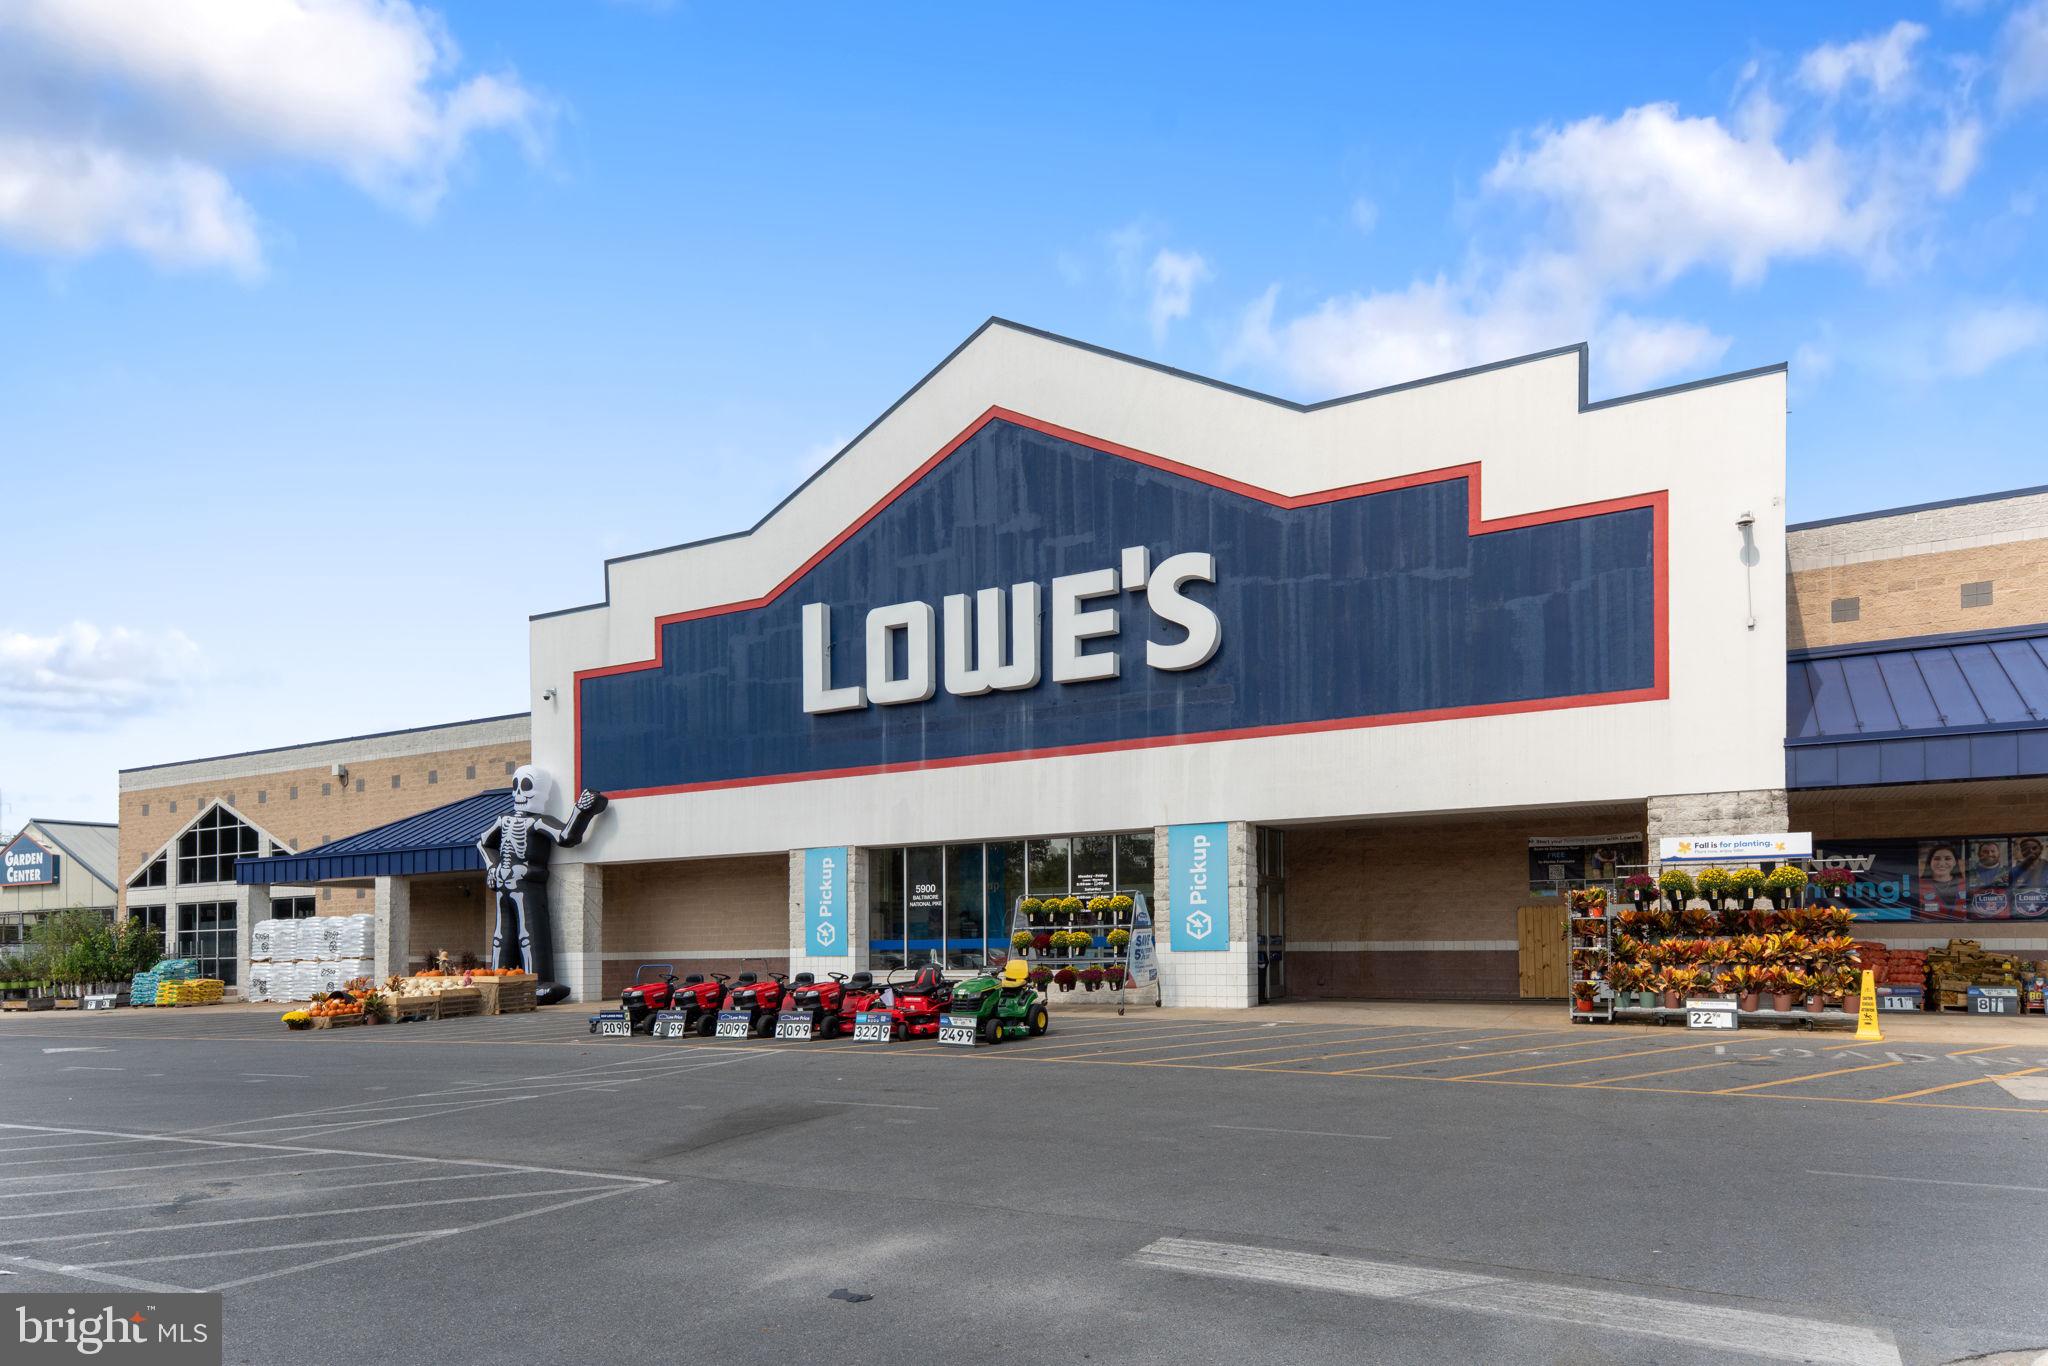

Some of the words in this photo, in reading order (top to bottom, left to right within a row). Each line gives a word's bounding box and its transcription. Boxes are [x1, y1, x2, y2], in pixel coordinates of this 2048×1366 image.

[802, 545, 1221, 715] LOWE'S
[1734, 840, 1773, 849] planting.
[5, 851, 43, 866] GARDEN
[7, 867, 41, 882] CENTER
[1189, 834, 1211, 905] Pickup
[819, 857, 835, 917] Pickup
[915, 884, 936, 893] 5900
[1135, 934, 1151, 947] SAVE
[1692, 1012, 1712, 1024] 22
[604, 1023, 630, 1034] 2099
[718, 1023, 747, 1035] 2099
[777, 1024, 809, 1036] 2099
[856, 1026, 890, 1038] 3229
[941, 1028, 973, 1042] 2499
